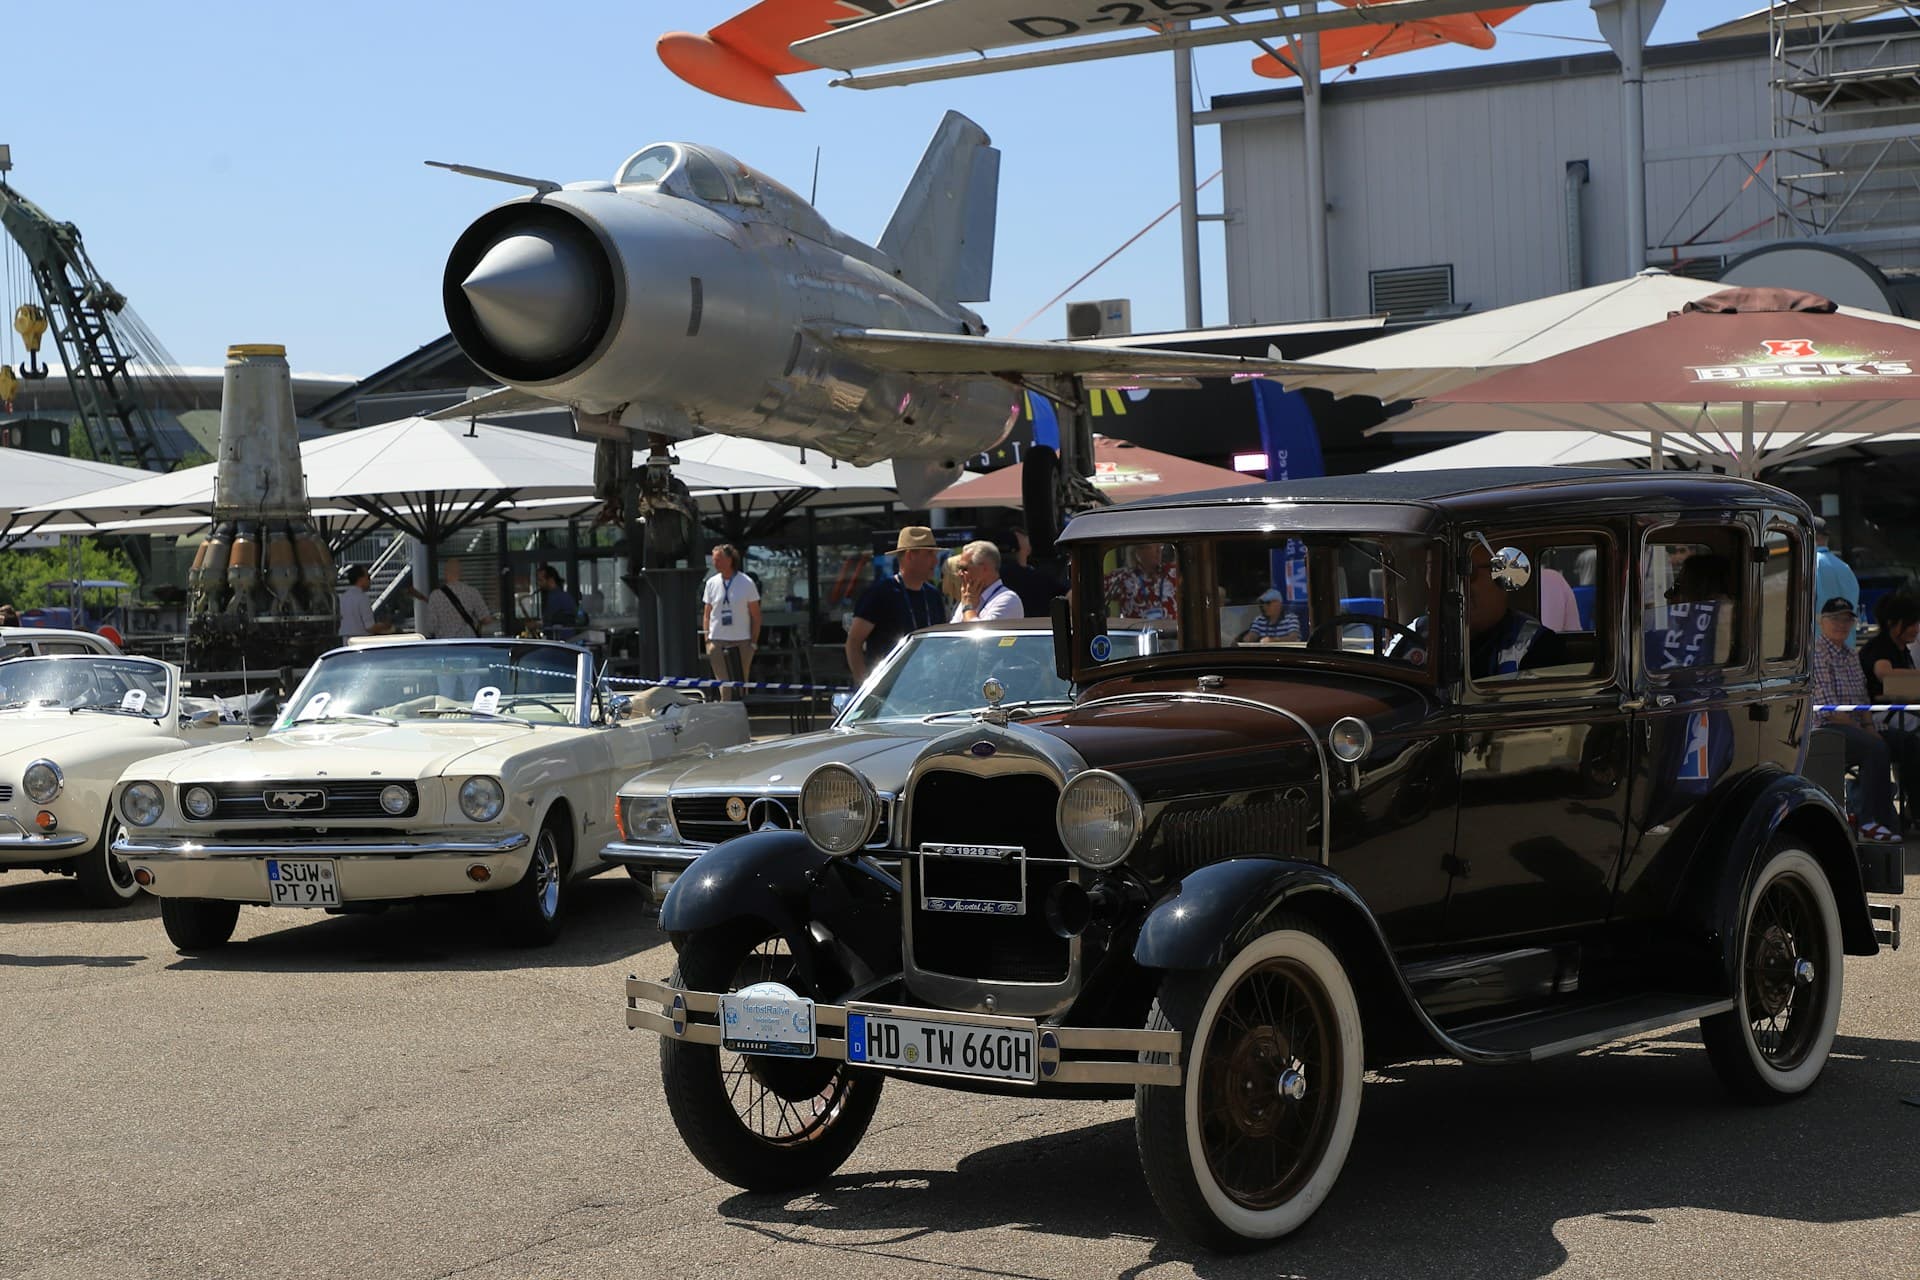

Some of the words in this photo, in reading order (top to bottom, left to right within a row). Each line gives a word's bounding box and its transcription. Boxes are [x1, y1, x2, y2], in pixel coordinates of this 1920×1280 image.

[1694, 361, 1912, 381] BECK'S
[956, 847, 985, 856] 1929
[280, 863, 319, 882] SÜW
[275, 883, 300, 902] PT
[948, 900, 981, 911] Model
[867, 1022, 900, 1059] HD
[921, 1027, 954, 1066] TW
[962, 1032, 1031, 1074] 660H
